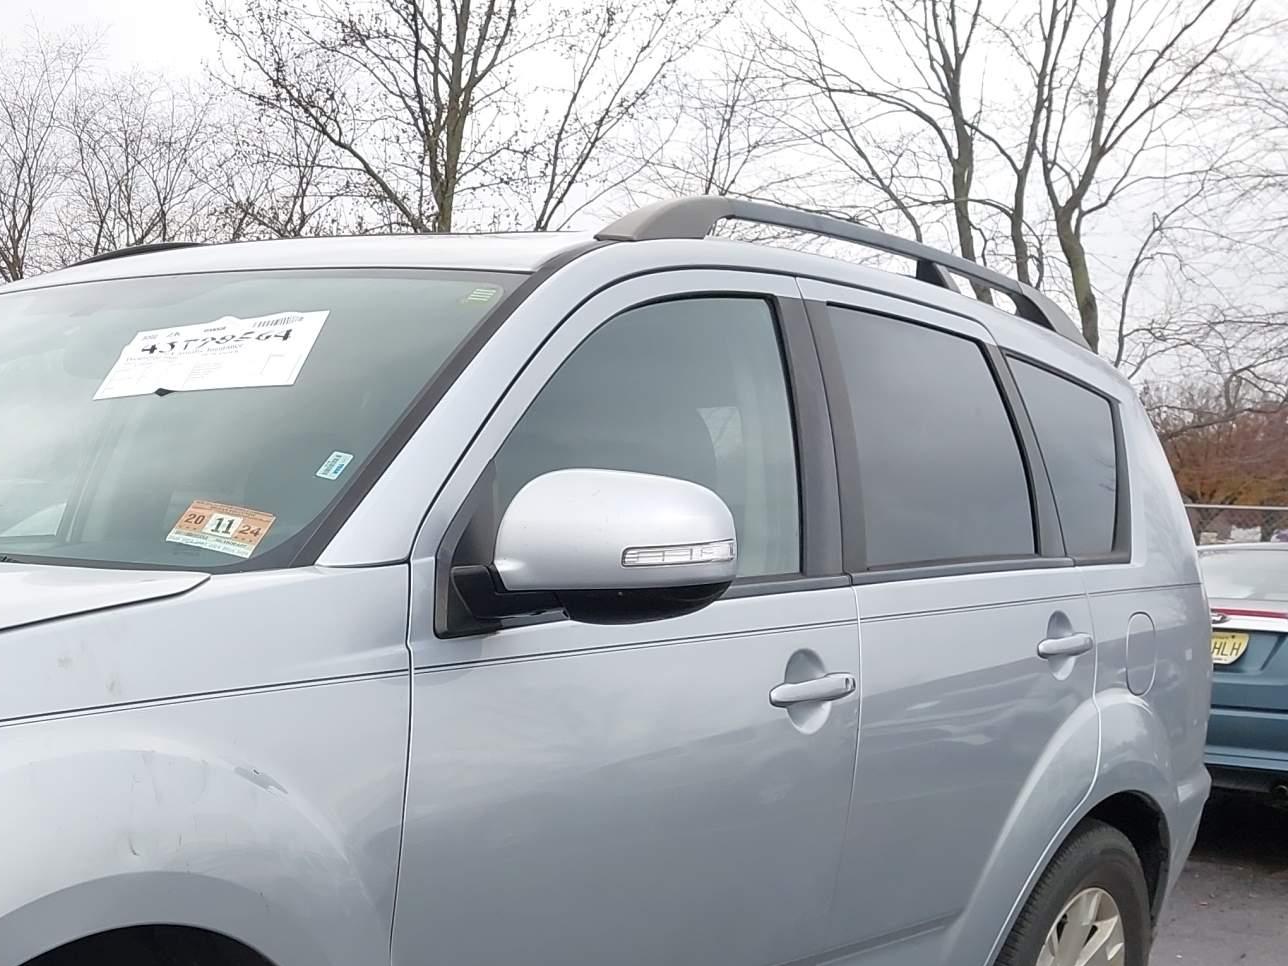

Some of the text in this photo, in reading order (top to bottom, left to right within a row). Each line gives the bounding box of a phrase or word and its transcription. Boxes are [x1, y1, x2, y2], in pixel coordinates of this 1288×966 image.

[184, 513, 262, 537] 20 11 24
